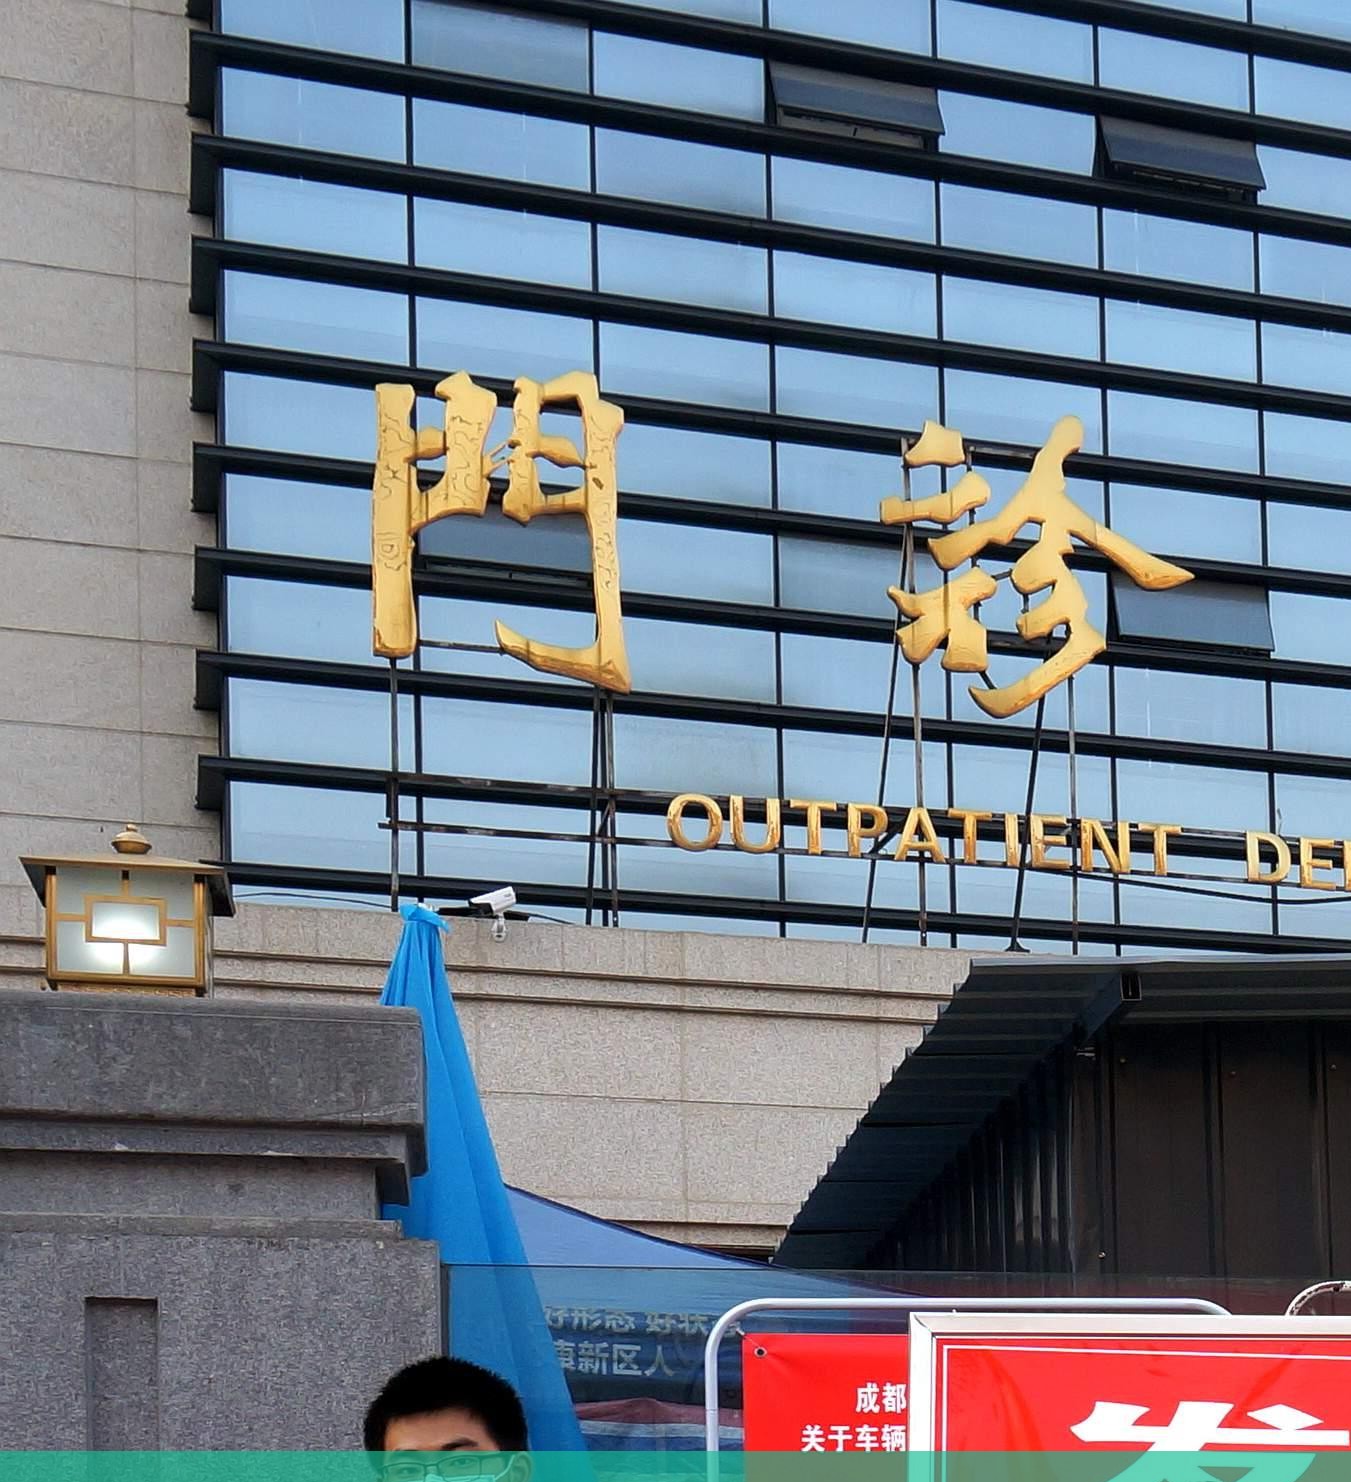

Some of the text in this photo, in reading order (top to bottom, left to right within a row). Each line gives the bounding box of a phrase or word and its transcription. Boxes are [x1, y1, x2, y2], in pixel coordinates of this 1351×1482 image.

[666, 793, 1182, 877] OUTPATIENT
[856, 1382, 907, 1413] 成都
[801, 1425, 907, 1452] 关于车辆
